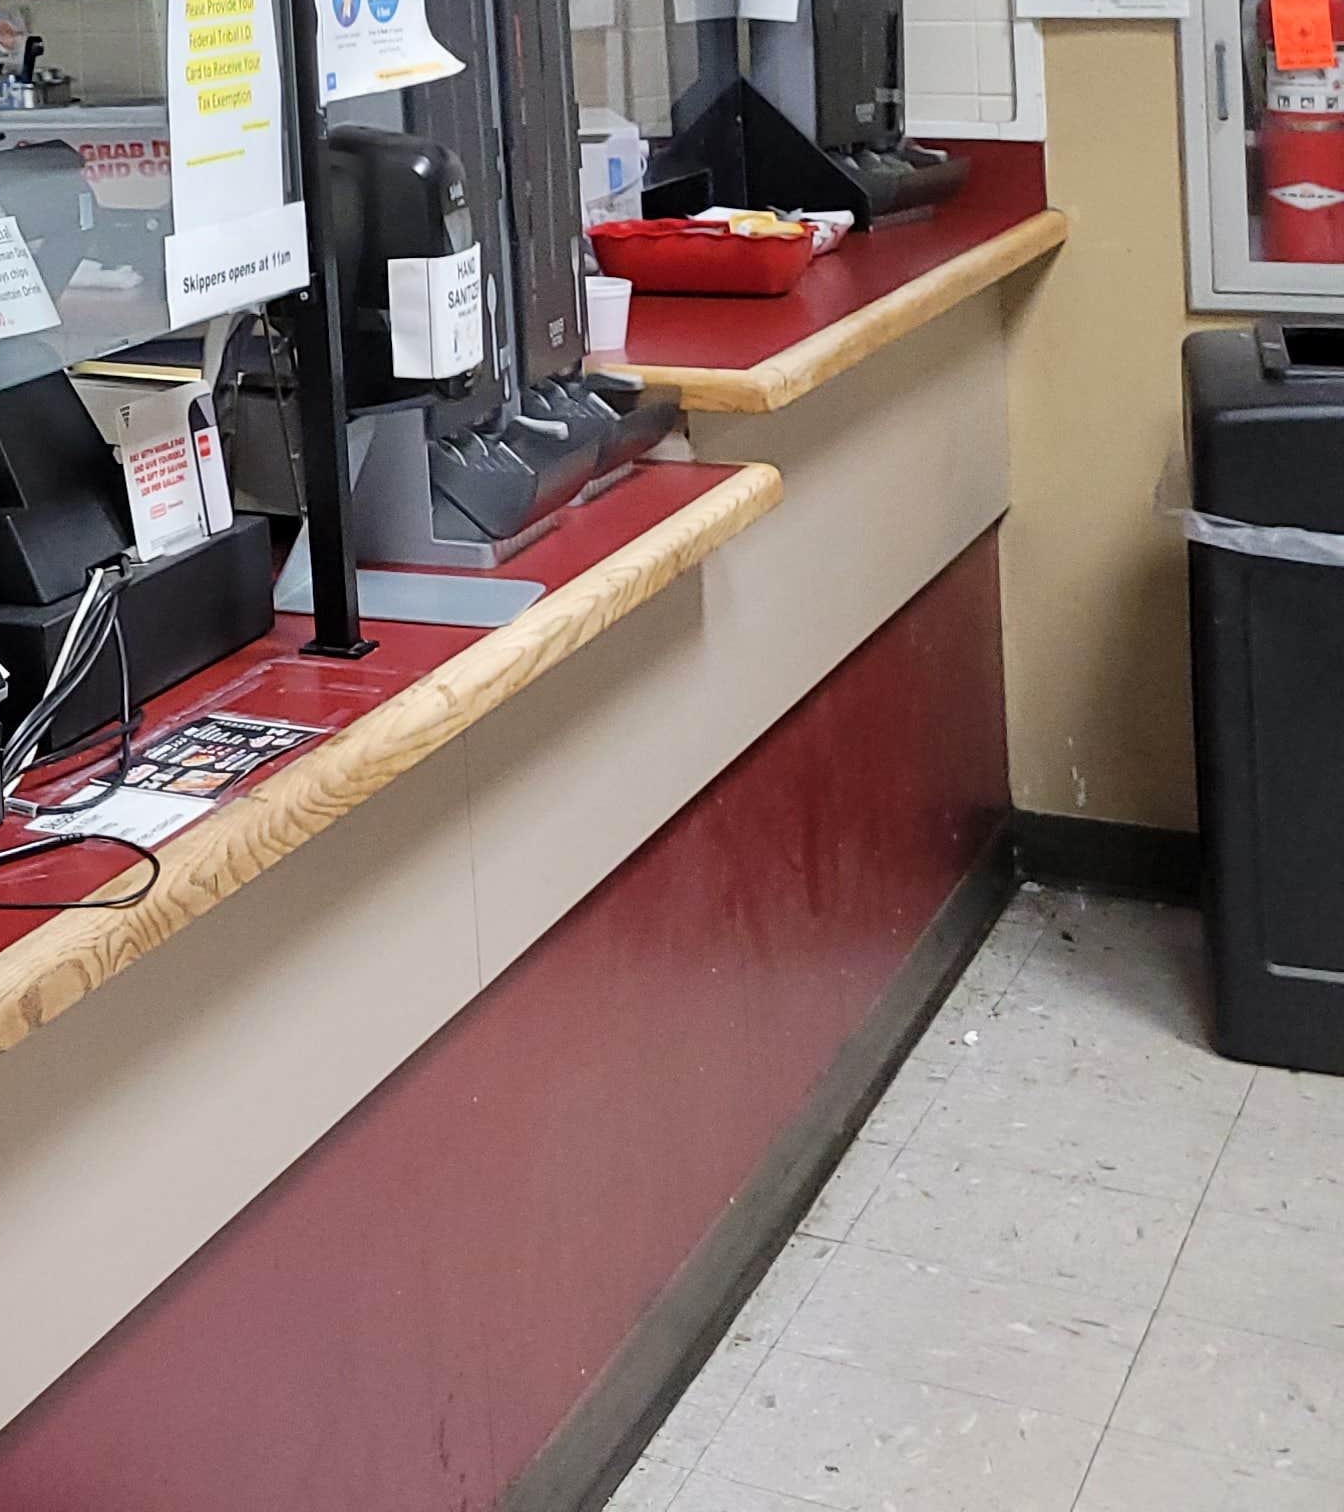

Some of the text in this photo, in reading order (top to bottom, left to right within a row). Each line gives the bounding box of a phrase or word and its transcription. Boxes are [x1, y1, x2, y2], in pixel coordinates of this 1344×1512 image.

[189, 31, 216, 50] Federal
[185, 56, 261, 83] Card to Receive Your
[197, 88, 253, 113] Tax Exemption
[79, 142, 145, 162] GRAB
[182, 249, 292, 295] Skippers opens at 11am
